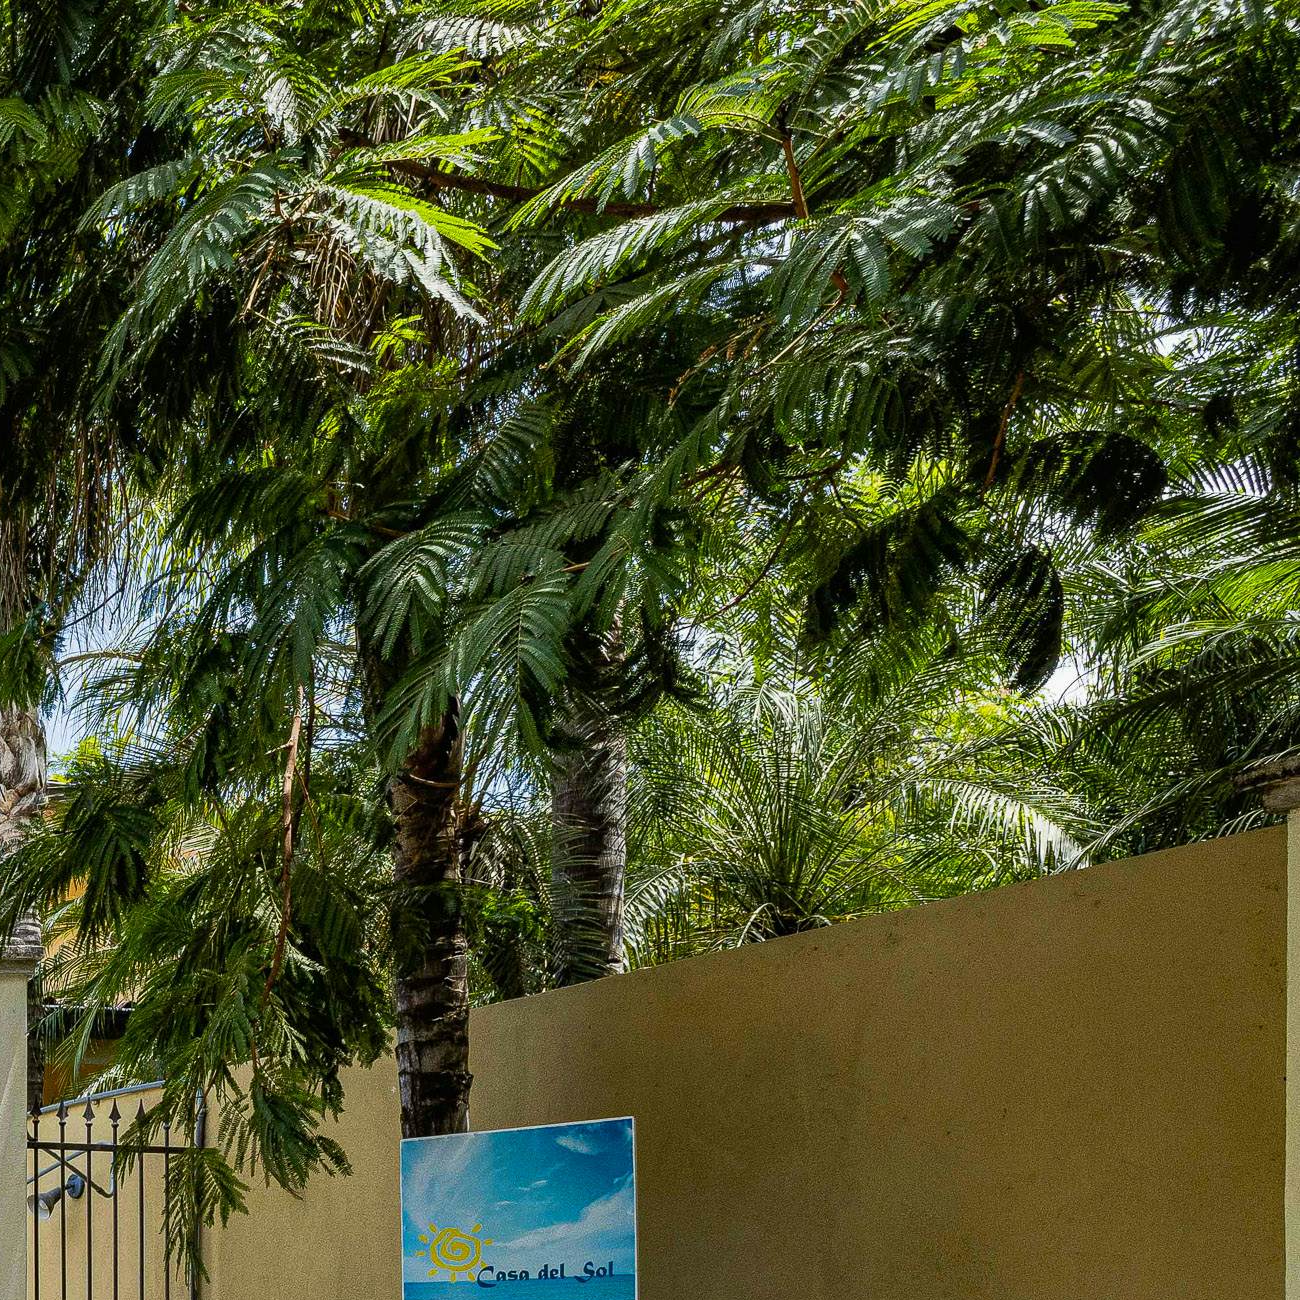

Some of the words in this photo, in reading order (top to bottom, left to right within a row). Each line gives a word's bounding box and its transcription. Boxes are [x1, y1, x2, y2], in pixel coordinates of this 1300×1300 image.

[476, 1265, 530, 1288] Casa
[538, 1263, 565, 1280] del
[574, 1261, 614, 1283] Sol
